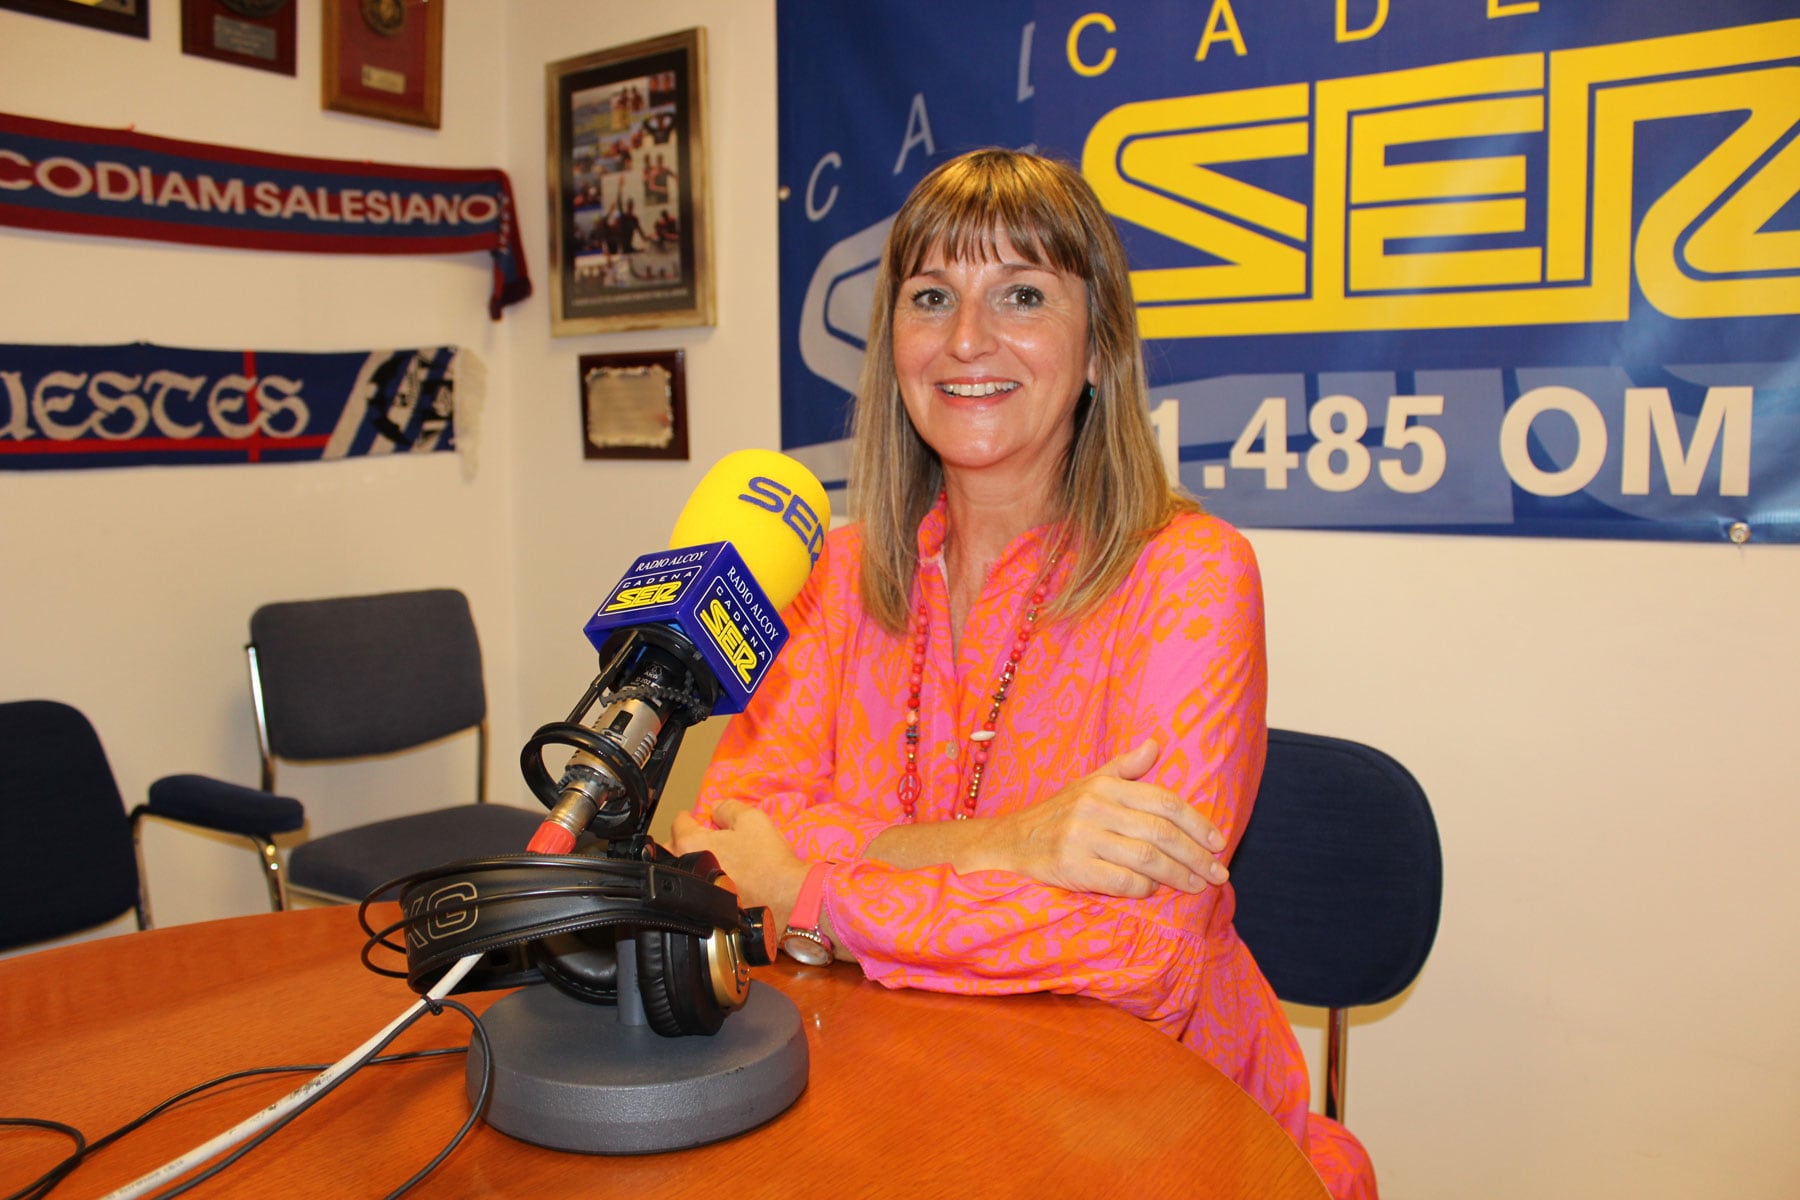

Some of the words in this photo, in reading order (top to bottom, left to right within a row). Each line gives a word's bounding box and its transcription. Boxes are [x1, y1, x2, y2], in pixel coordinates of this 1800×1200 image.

[254, 178, 498, 225] SALESIANO
[1081, 18, 1800, 339] SER
[1149, 394, 1447, 494] 1.485
[1500, 386, 1754, 497] OM
[605, 581, 682, 612] SER
[622, 571, 692, 589] CADENA
[635, 558, 670, 572] RADIO
[668, 551, 708, 566] ALCOY
[716, 585, 765, 661] CADENA
[727, 566, 754, 605] RADIO
[750, 603, 779, 640] ALCOY
[699, 599, 757, 685] SER
